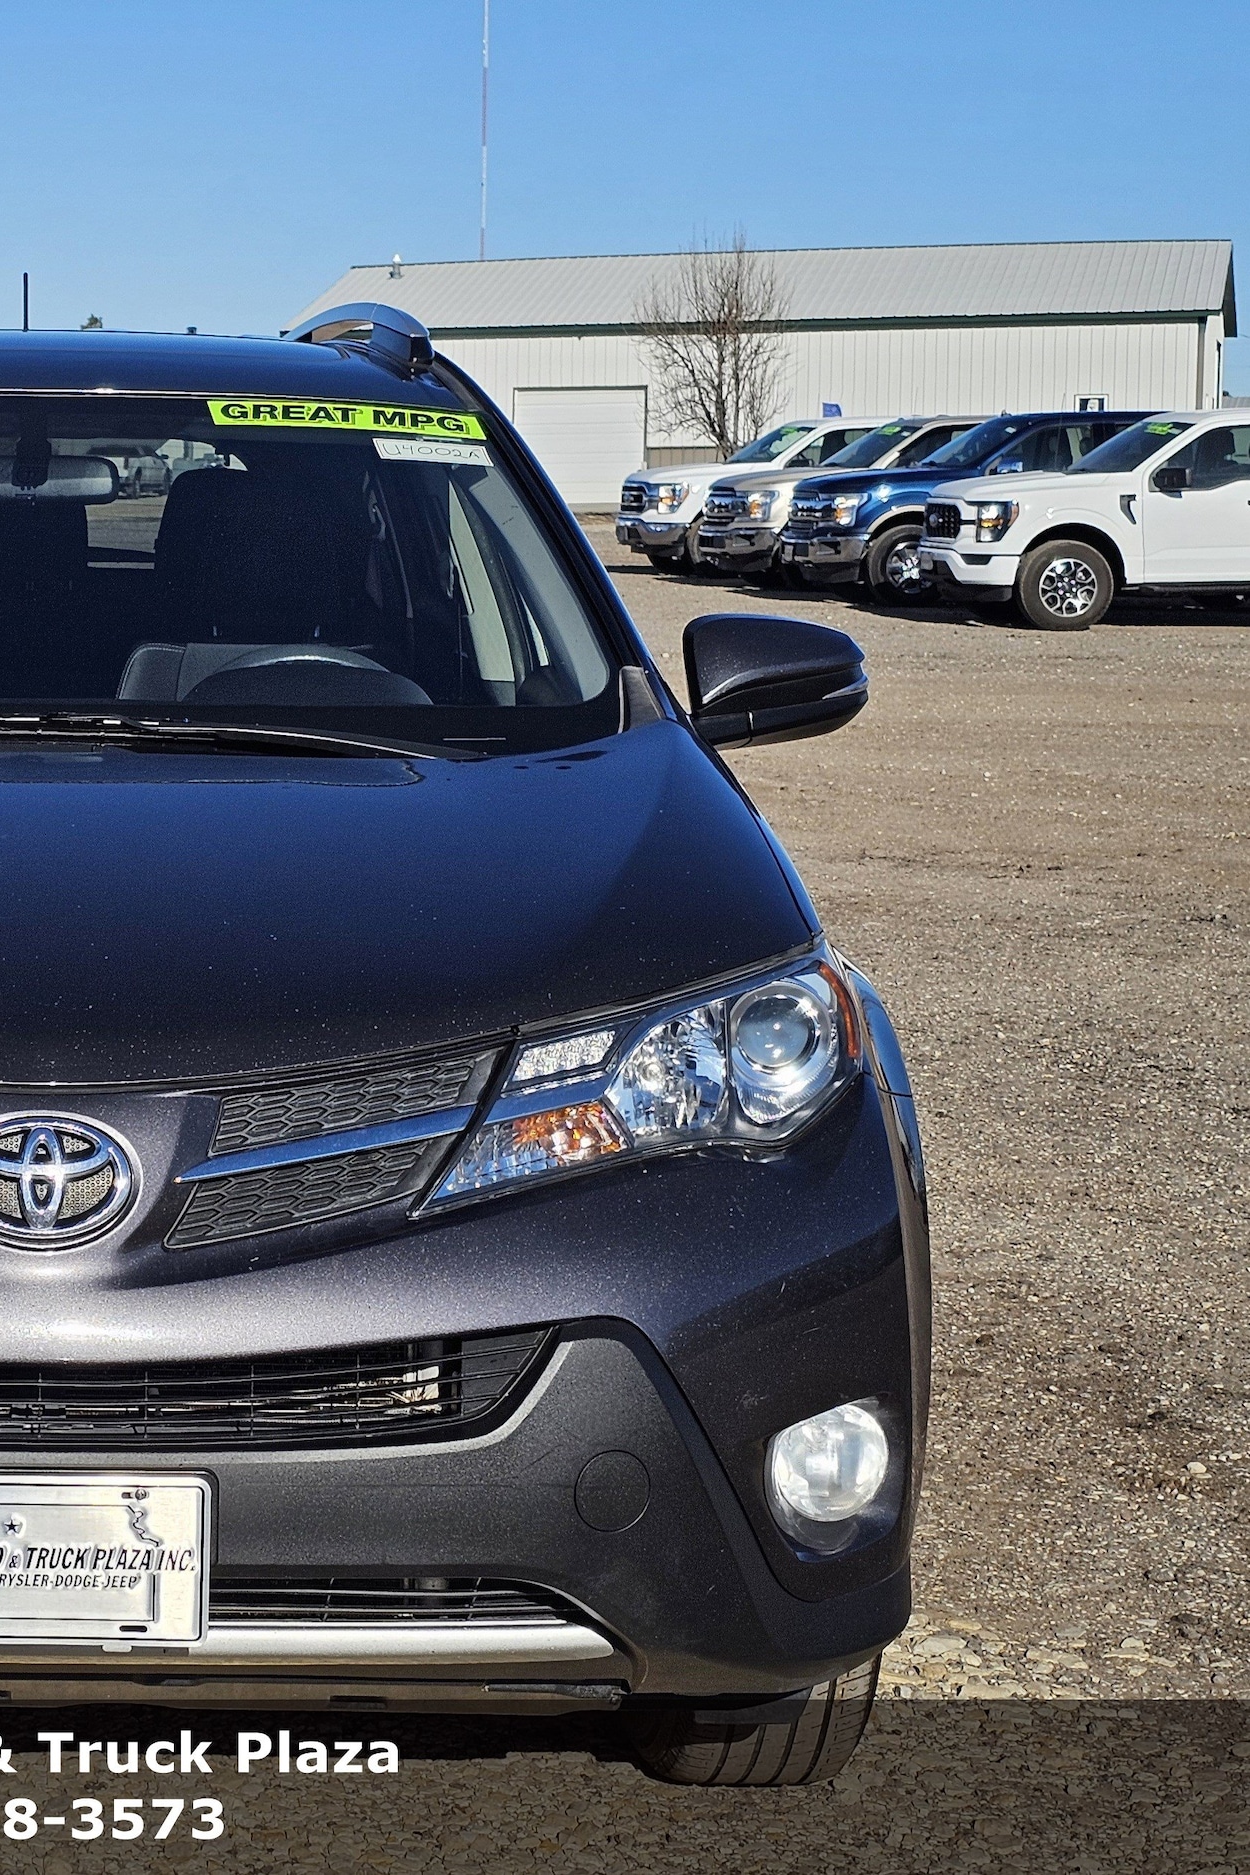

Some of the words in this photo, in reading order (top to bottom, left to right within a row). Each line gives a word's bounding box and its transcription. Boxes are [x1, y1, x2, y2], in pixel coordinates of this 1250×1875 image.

[220, 403, 363, 425] GREAT
[372, 409, 470, 434] MPG
[8, 1555, 18, 1569] &
[26, 1547, 86, 1569] TRUCK
[92, 1549, 151, 1570] PLAZA
[158, 1549, 196, 1571] INC.
